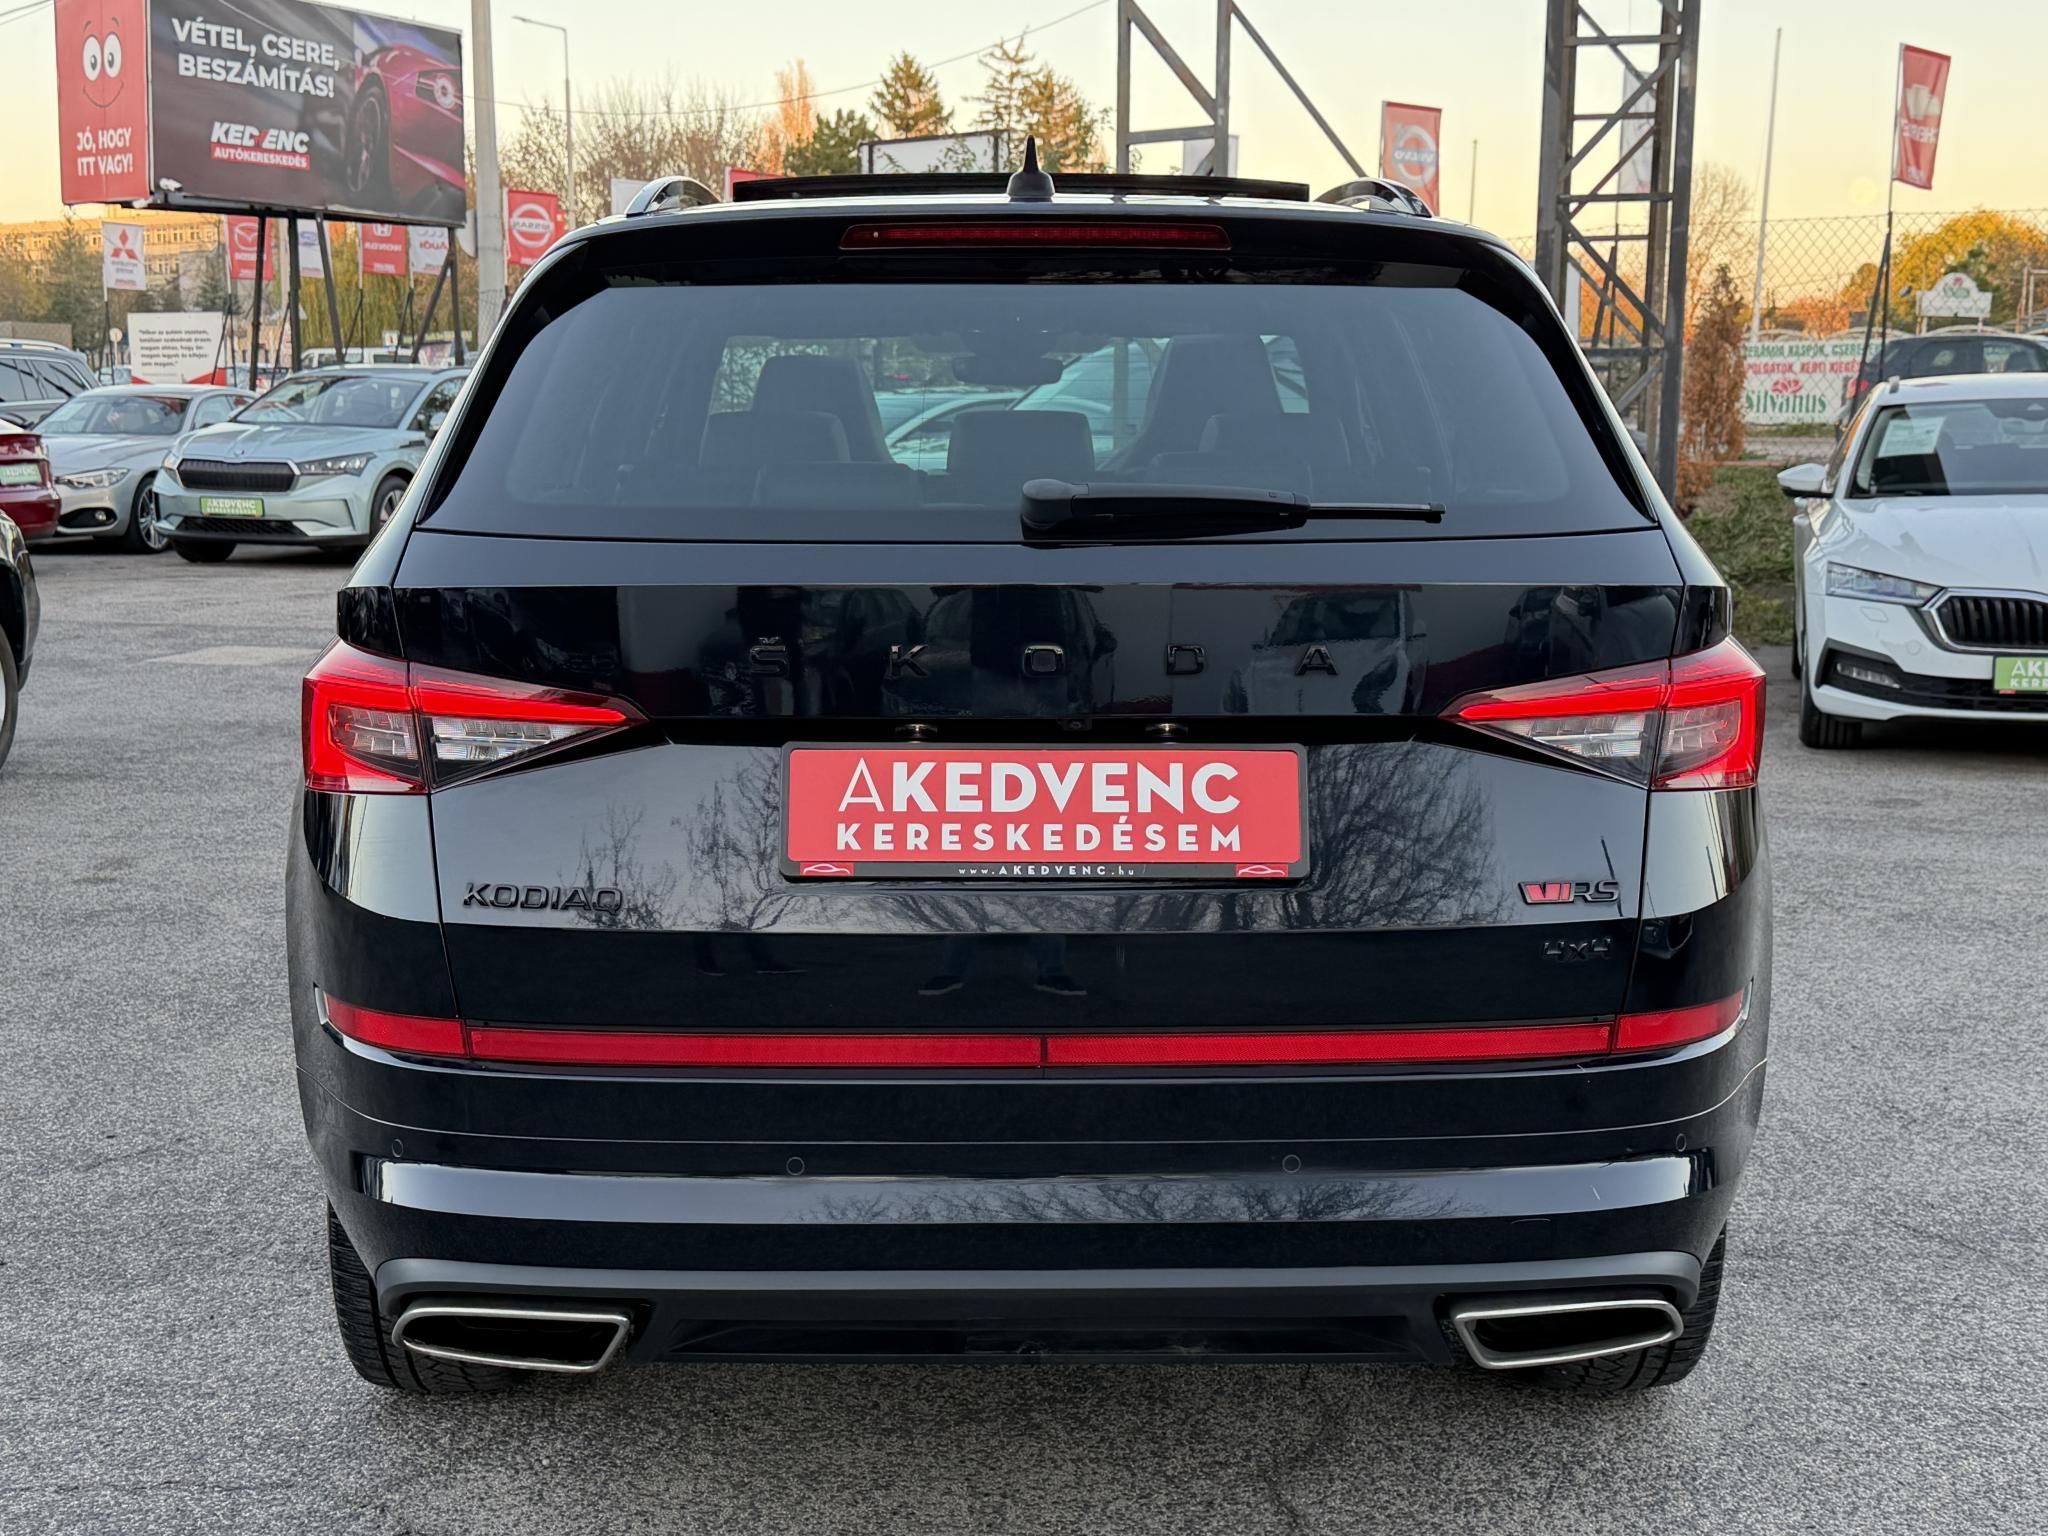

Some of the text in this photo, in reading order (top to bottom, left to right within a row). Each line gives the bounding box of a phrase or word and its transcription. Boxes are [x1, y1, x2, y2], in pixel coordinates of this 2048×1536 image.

[171, 16, 340, 72] VÉTEL, CSERE,
[178, 53, 335, 98] BESZÁMÍTÁS!
[76, 125, 132, 154] JÓ, HOGY
[77, 152, 134, 177] ITT VAGY!
[214, 147, 308, 168] AUTÓKERESKEDÉS
[748, 636, 1339, 679] ŠKODA
[837, 757, 1241, 814] AKEDVENC
[836, 816, 1241, 851] KERESKEDÉSEM
[958, 865, 1135, 876] www.AKEDVENC.hu
[462, 882, 624, 915] KODIAQ
